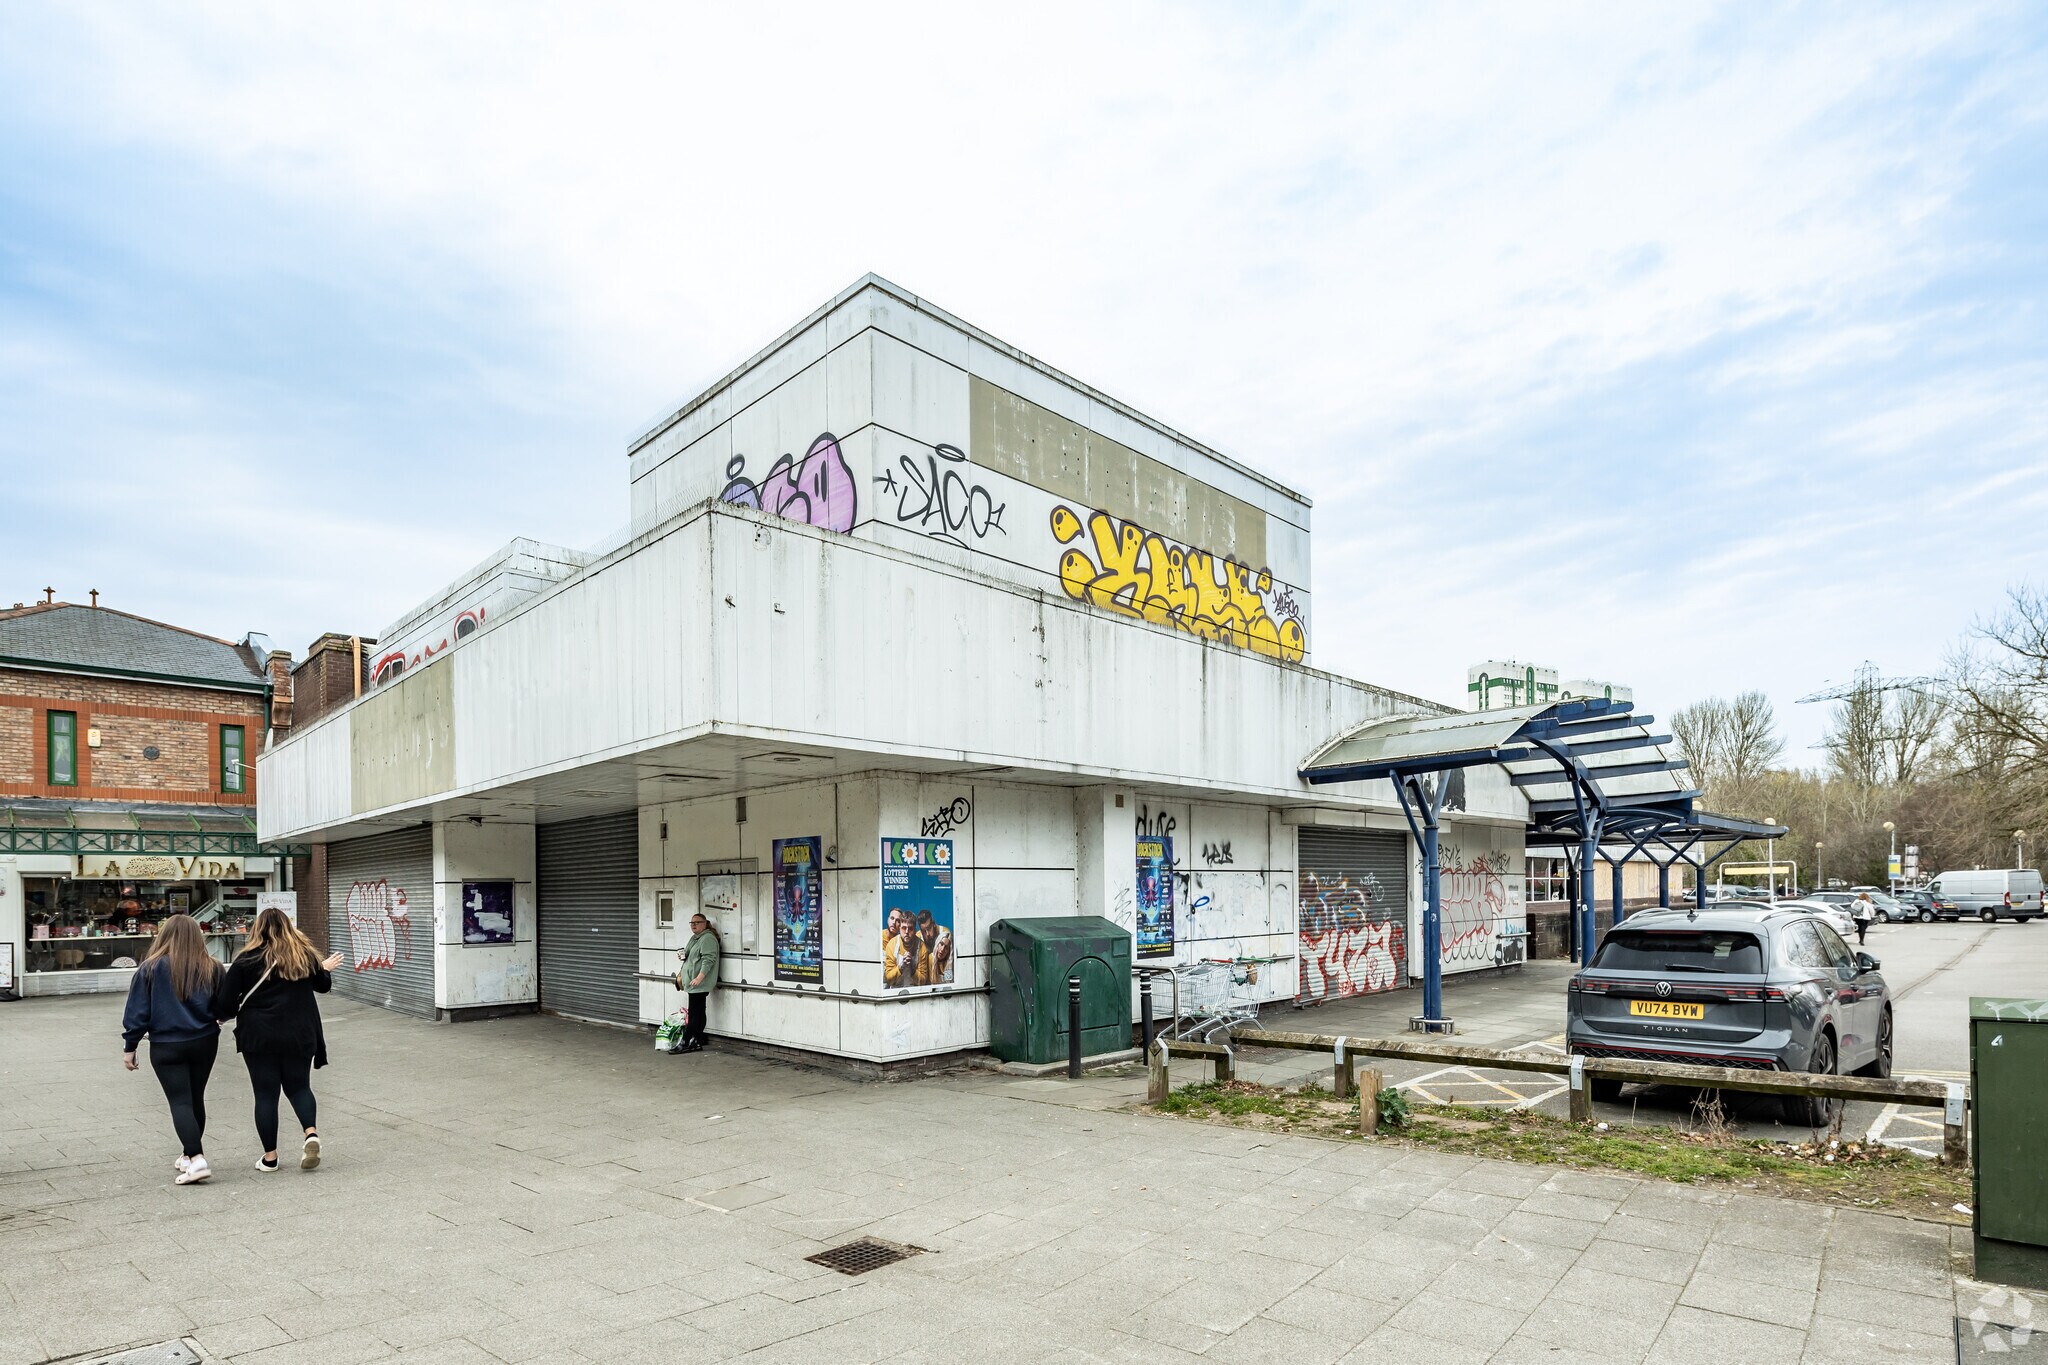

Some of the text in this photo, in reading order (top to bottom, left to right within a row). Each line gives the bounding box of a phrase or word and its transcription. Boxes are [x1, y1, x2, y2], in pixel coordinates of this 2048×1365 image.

[884, 869, 908, 877] LOTTERY
[1637, 1002, 1698, 1017] VU74 BVW
[1643, 1025, 1688, 1033] TIGUAN
